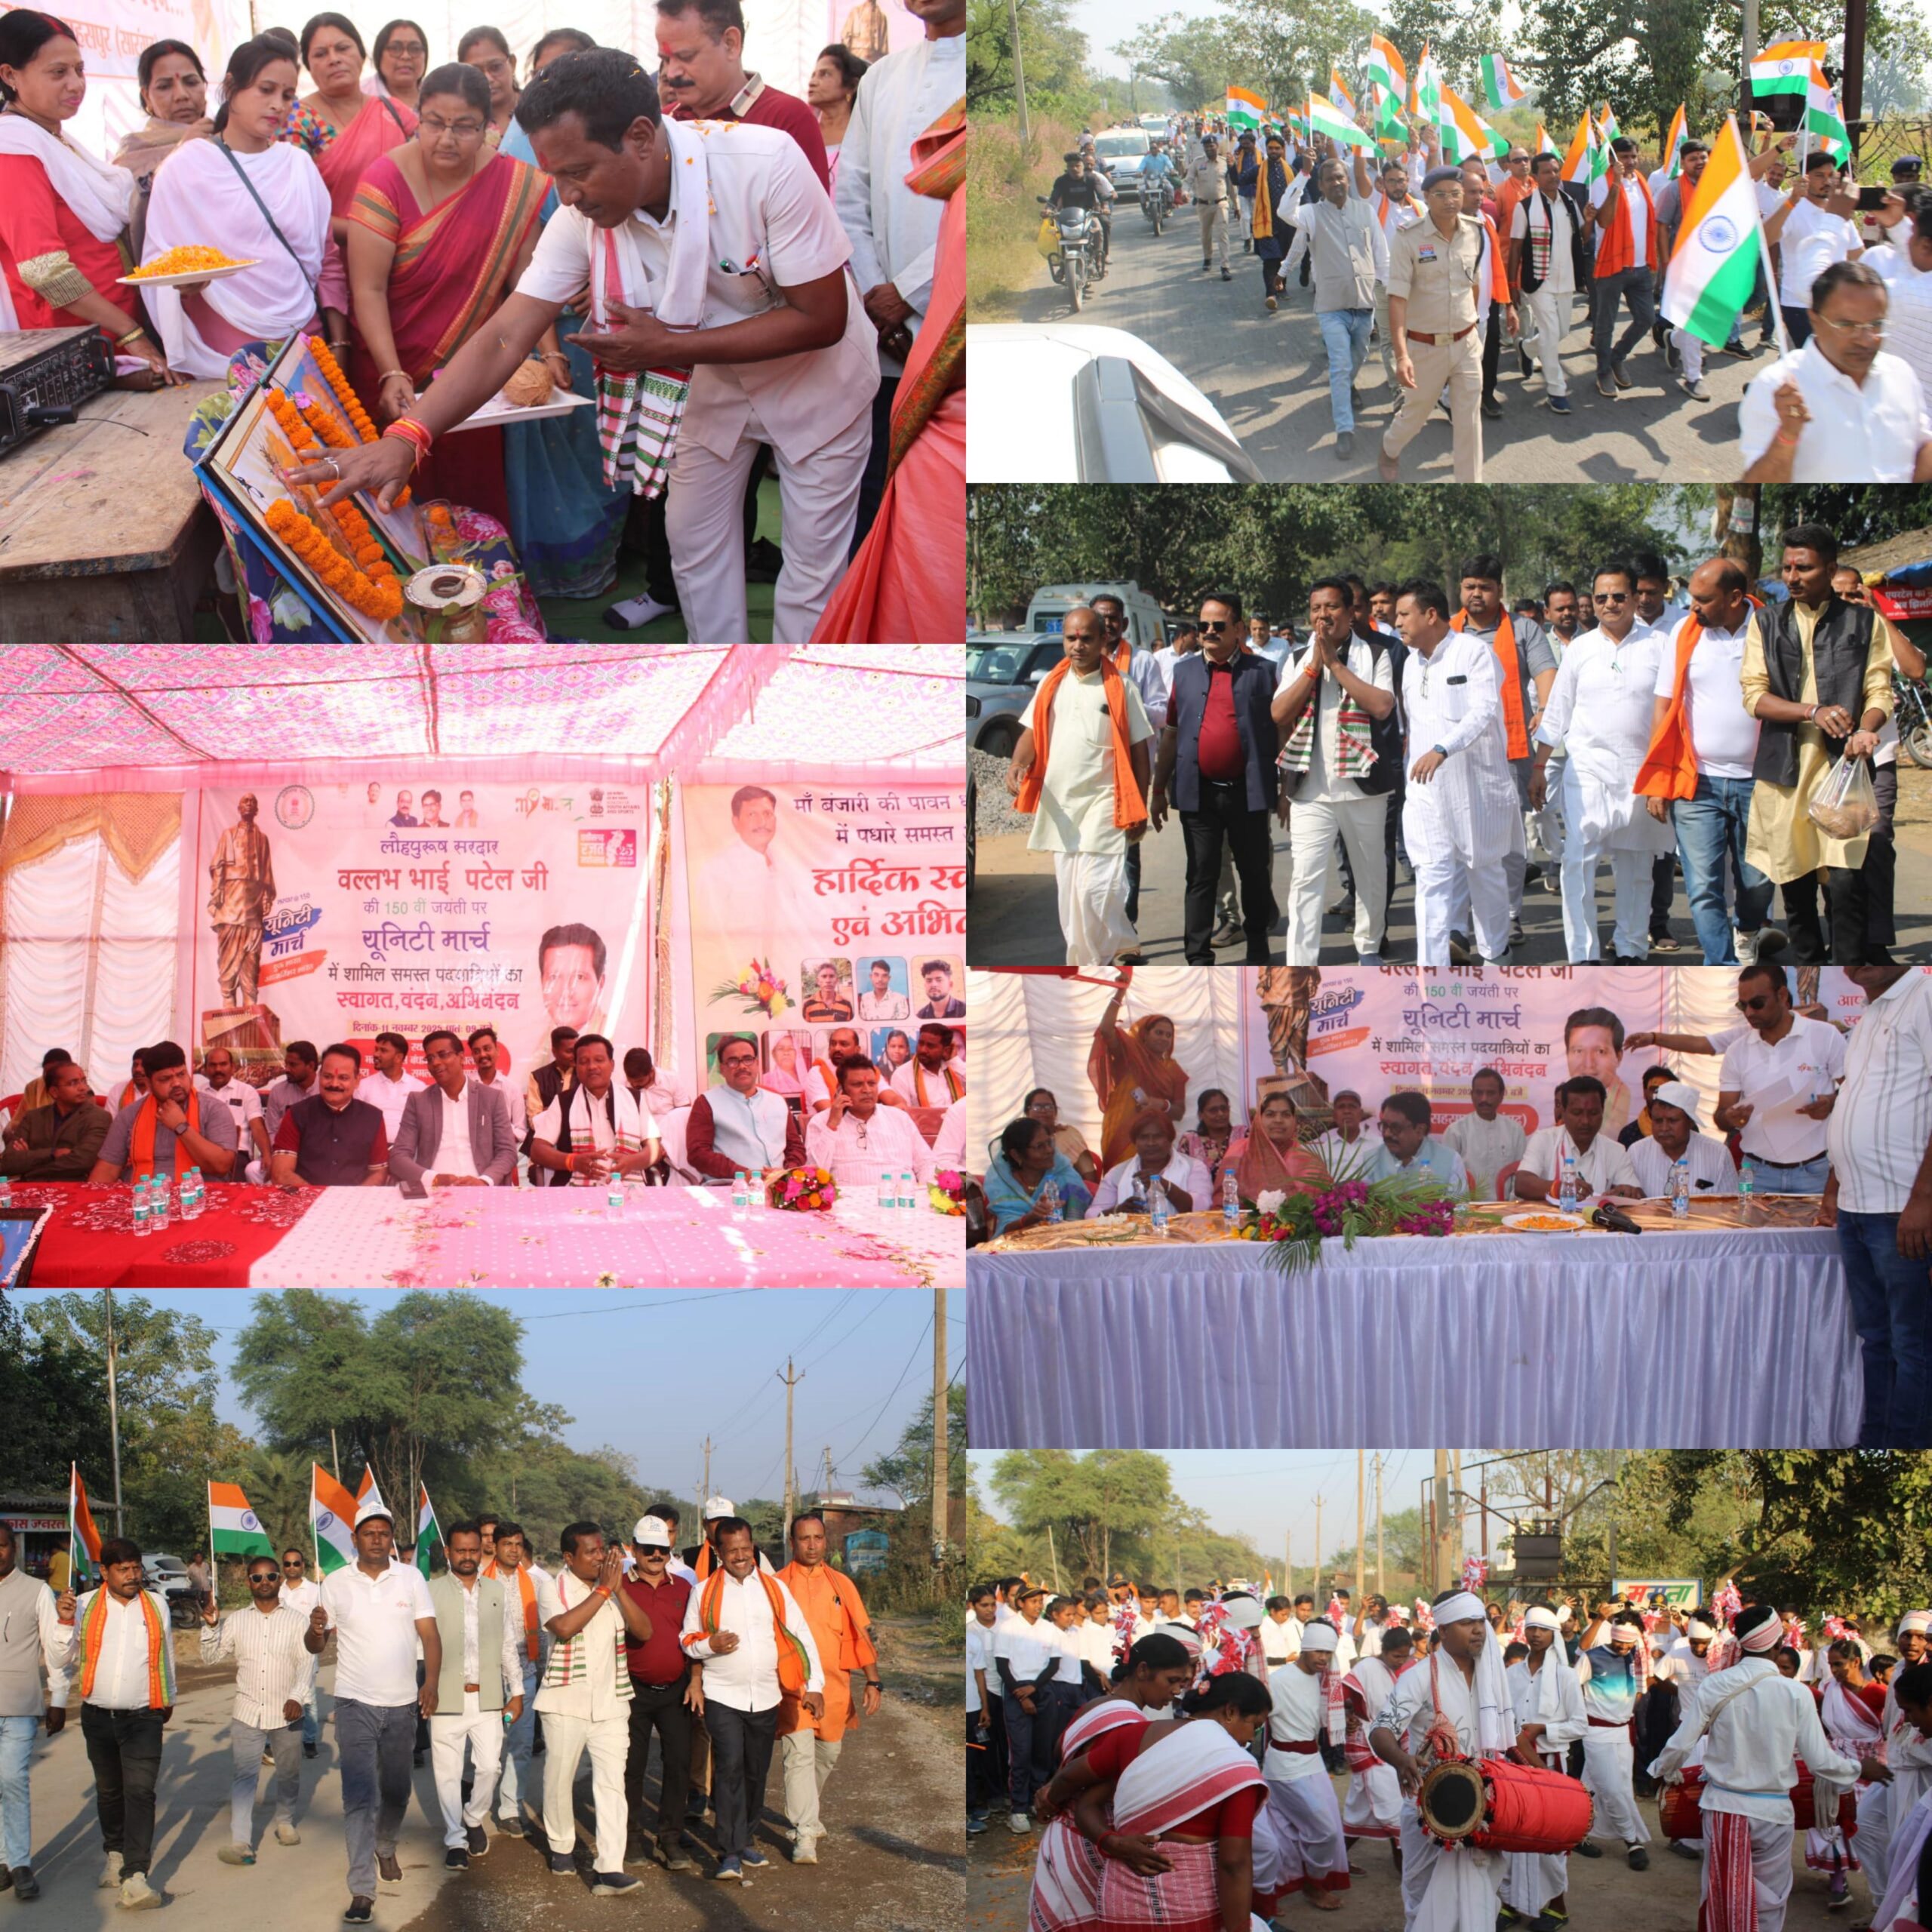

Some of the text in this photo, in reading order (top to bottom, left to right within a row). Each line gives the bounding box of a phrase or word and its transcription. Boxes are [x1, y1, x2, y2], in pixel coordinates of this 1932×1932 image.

[794, 792, 813, 813] माँ
[821, 791, 869, 813] बंजारी
[879, 790, 900, 812] की
[908, 795, 951, 811] पावन
[835, 821, 953, 844] में पधारे समस्त
[454, 839, 499, 856] सरदार
[337, 860, 549, 895] वल्लभ भाई पटेल जी
[812, 857, 921, 897] हार्दिक
[363, 897, 380, 915] की
[385, 901, 408, 915] 150
[431, 897, 467, 915] जयंती
[472, 900, 488, 915] पर
[263, 904, 313, 935] यूनिटी
[831, 905, 870, 946] एवं
[271, 928, 307, 957] मार्च
[362, 921, 491, 961] यूनिटी मार्च
[328, 962, 340, 981] में
[344, 962, 385, 982] शामिल
[391, 968, 429, 983] समस्त
[506, 968, 522, 983] का
[1310, 986, 1356, 1015] यूनिटी
[1404, 983, 1418, 997] की
[1425, 987, 1446, 997] 150
[1466, 983, 1500, 998] जयंती
[1504, 987, 1518, 998] पर
[1317, 1008, 1351, 1032] मार्च
[1402, 1003, 1521, 1035] यूनिटी मार्च
[1371, 1037, 1382, 1052] में
[1386, 1038, 1425, 1053] शामिल
[1471, 1039, 1531, 1055] पदयात्रियों
[1534, 1043, 1550, 1055] का
